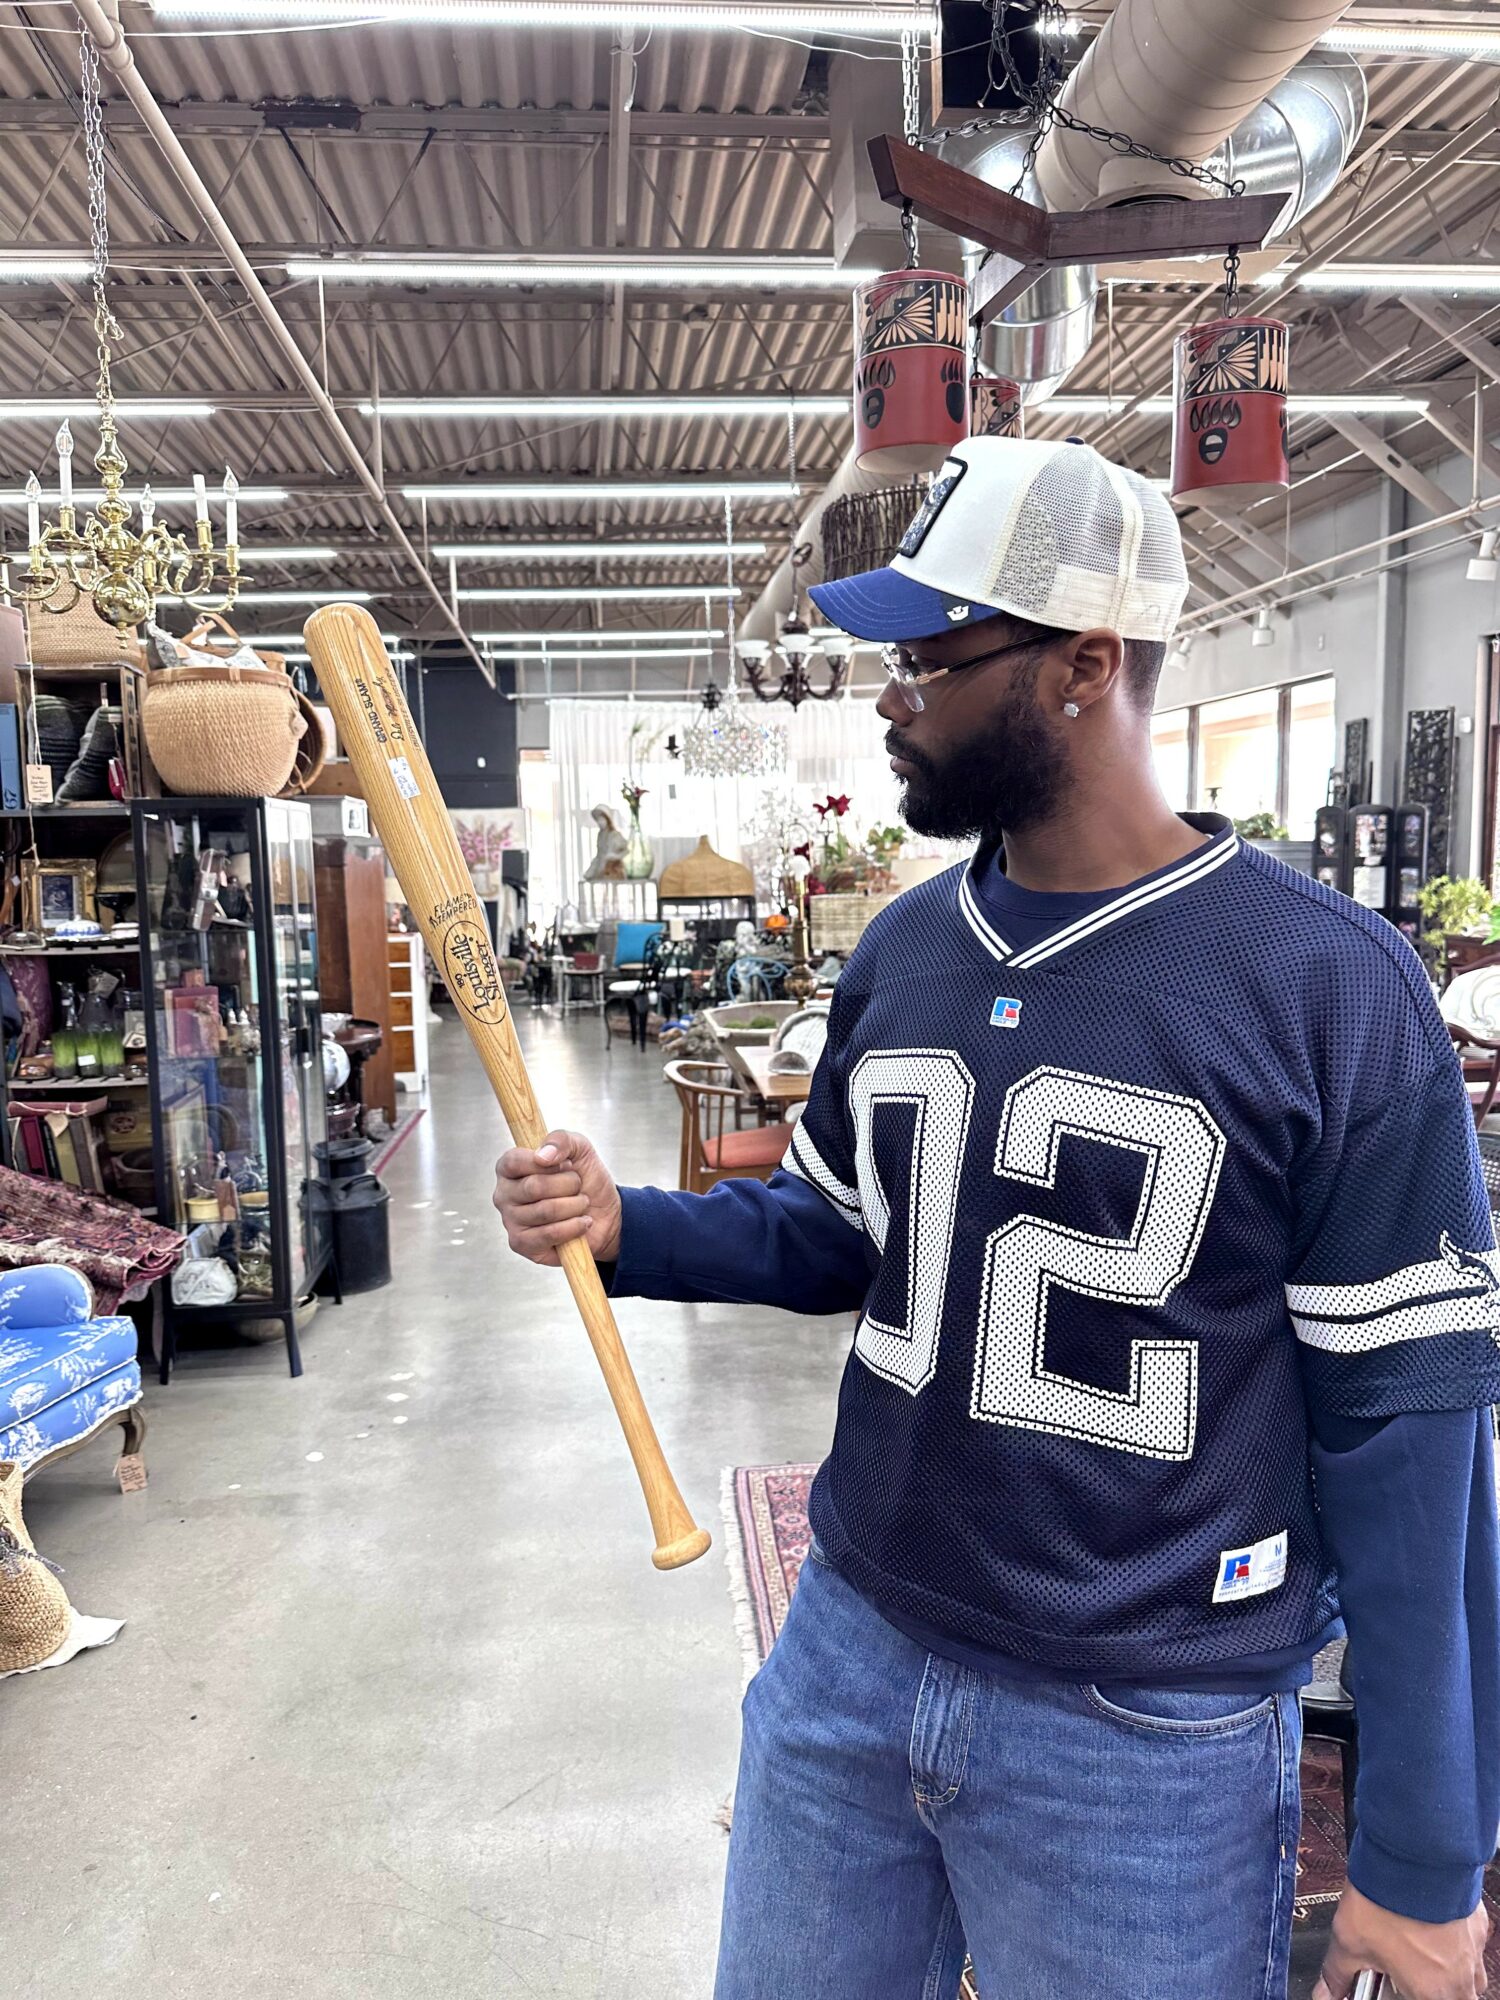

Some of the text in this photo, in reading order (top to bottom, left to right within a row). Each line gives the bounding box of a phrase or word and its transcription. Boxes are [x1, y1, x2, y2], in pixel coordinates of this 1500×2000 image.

[368, 711, 388, 744] GRAND
[436, 900, 478, 924] TEMPERED
[450, 933, 491, 1014] Louisville
[476, 942, 502, 1001] Slugger
